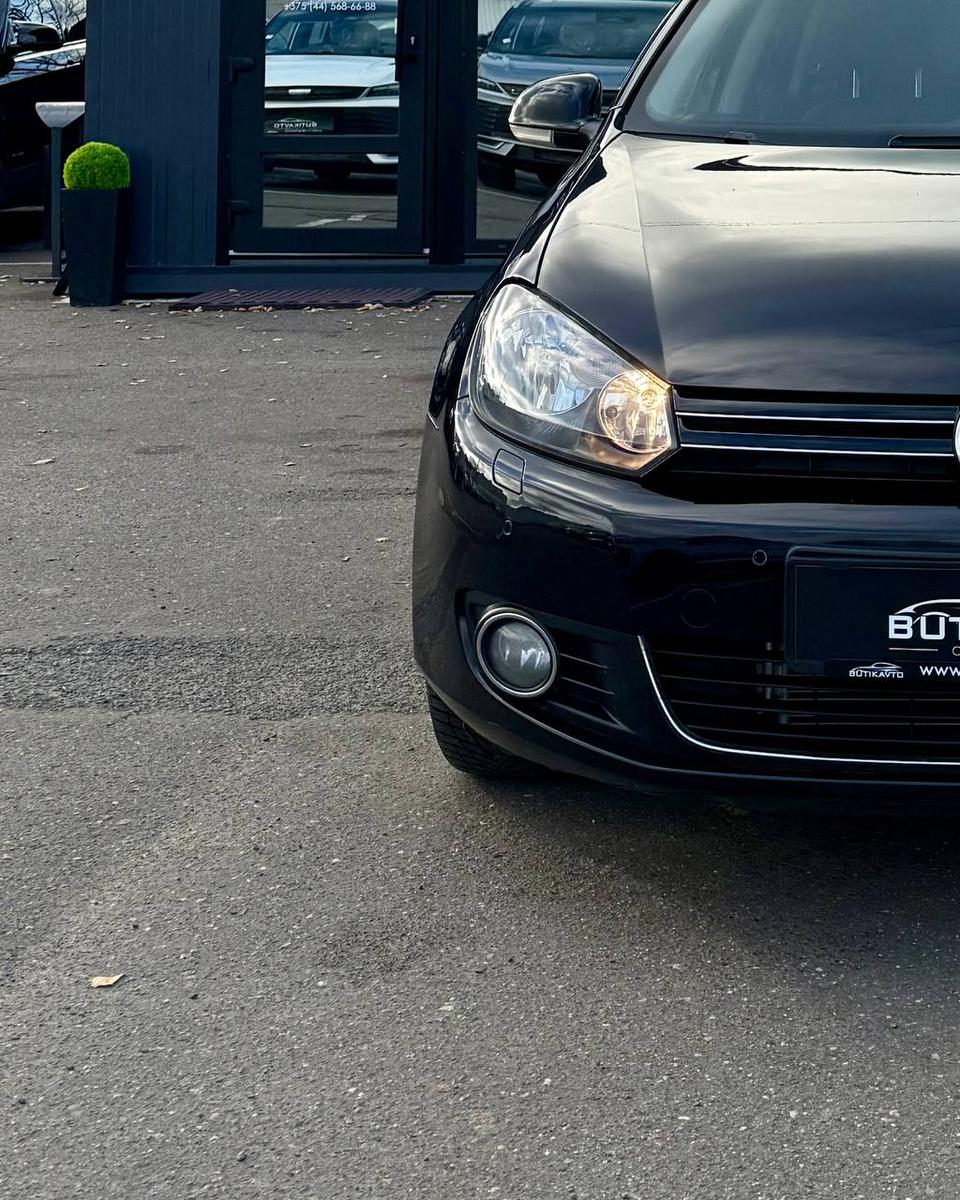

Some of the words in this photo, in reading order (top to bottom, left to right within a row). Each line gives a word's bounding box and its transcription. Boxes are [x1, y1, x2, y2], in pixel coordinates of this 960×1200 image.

[309, 1, 327, 12] (44)
[330, 2, 377, 11] 568-66-88
[848, 669, 904, 679] BUTIKAVTO
